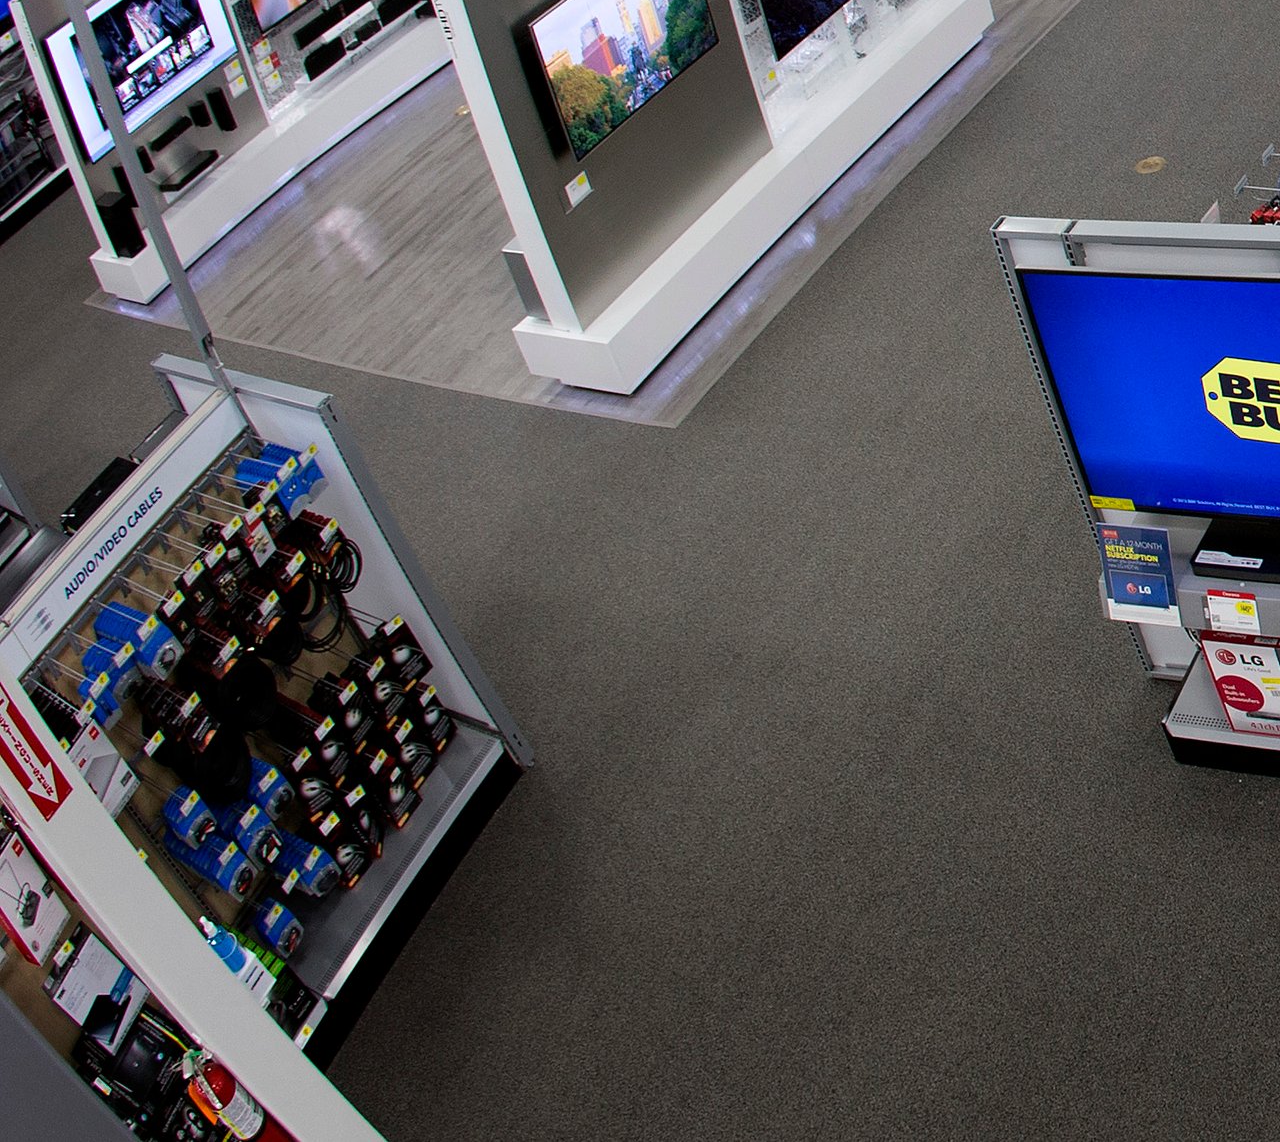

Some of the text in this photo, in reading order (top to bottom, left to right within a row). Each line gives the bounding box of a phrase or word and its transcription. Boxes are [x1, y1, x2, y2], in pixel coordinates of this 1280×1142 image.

[64, 486, 164, 600] AUDIO/VIDEO CABLES
[1104, 538, 1118, 546] GET
[1126, 540, 1163, 550] 12-MONTH
[1105, 545, 1134, 554] NETFLIX
[1106, 551, 1158, 563] SUBSCRIPTION
[1139, 585, 1151, 594] LG
[1240, 654, 1264, 666] LG
[1226, 695, 1260, 704] Subwoofers
[1250, 722, 1276, 731] 4.1ch
